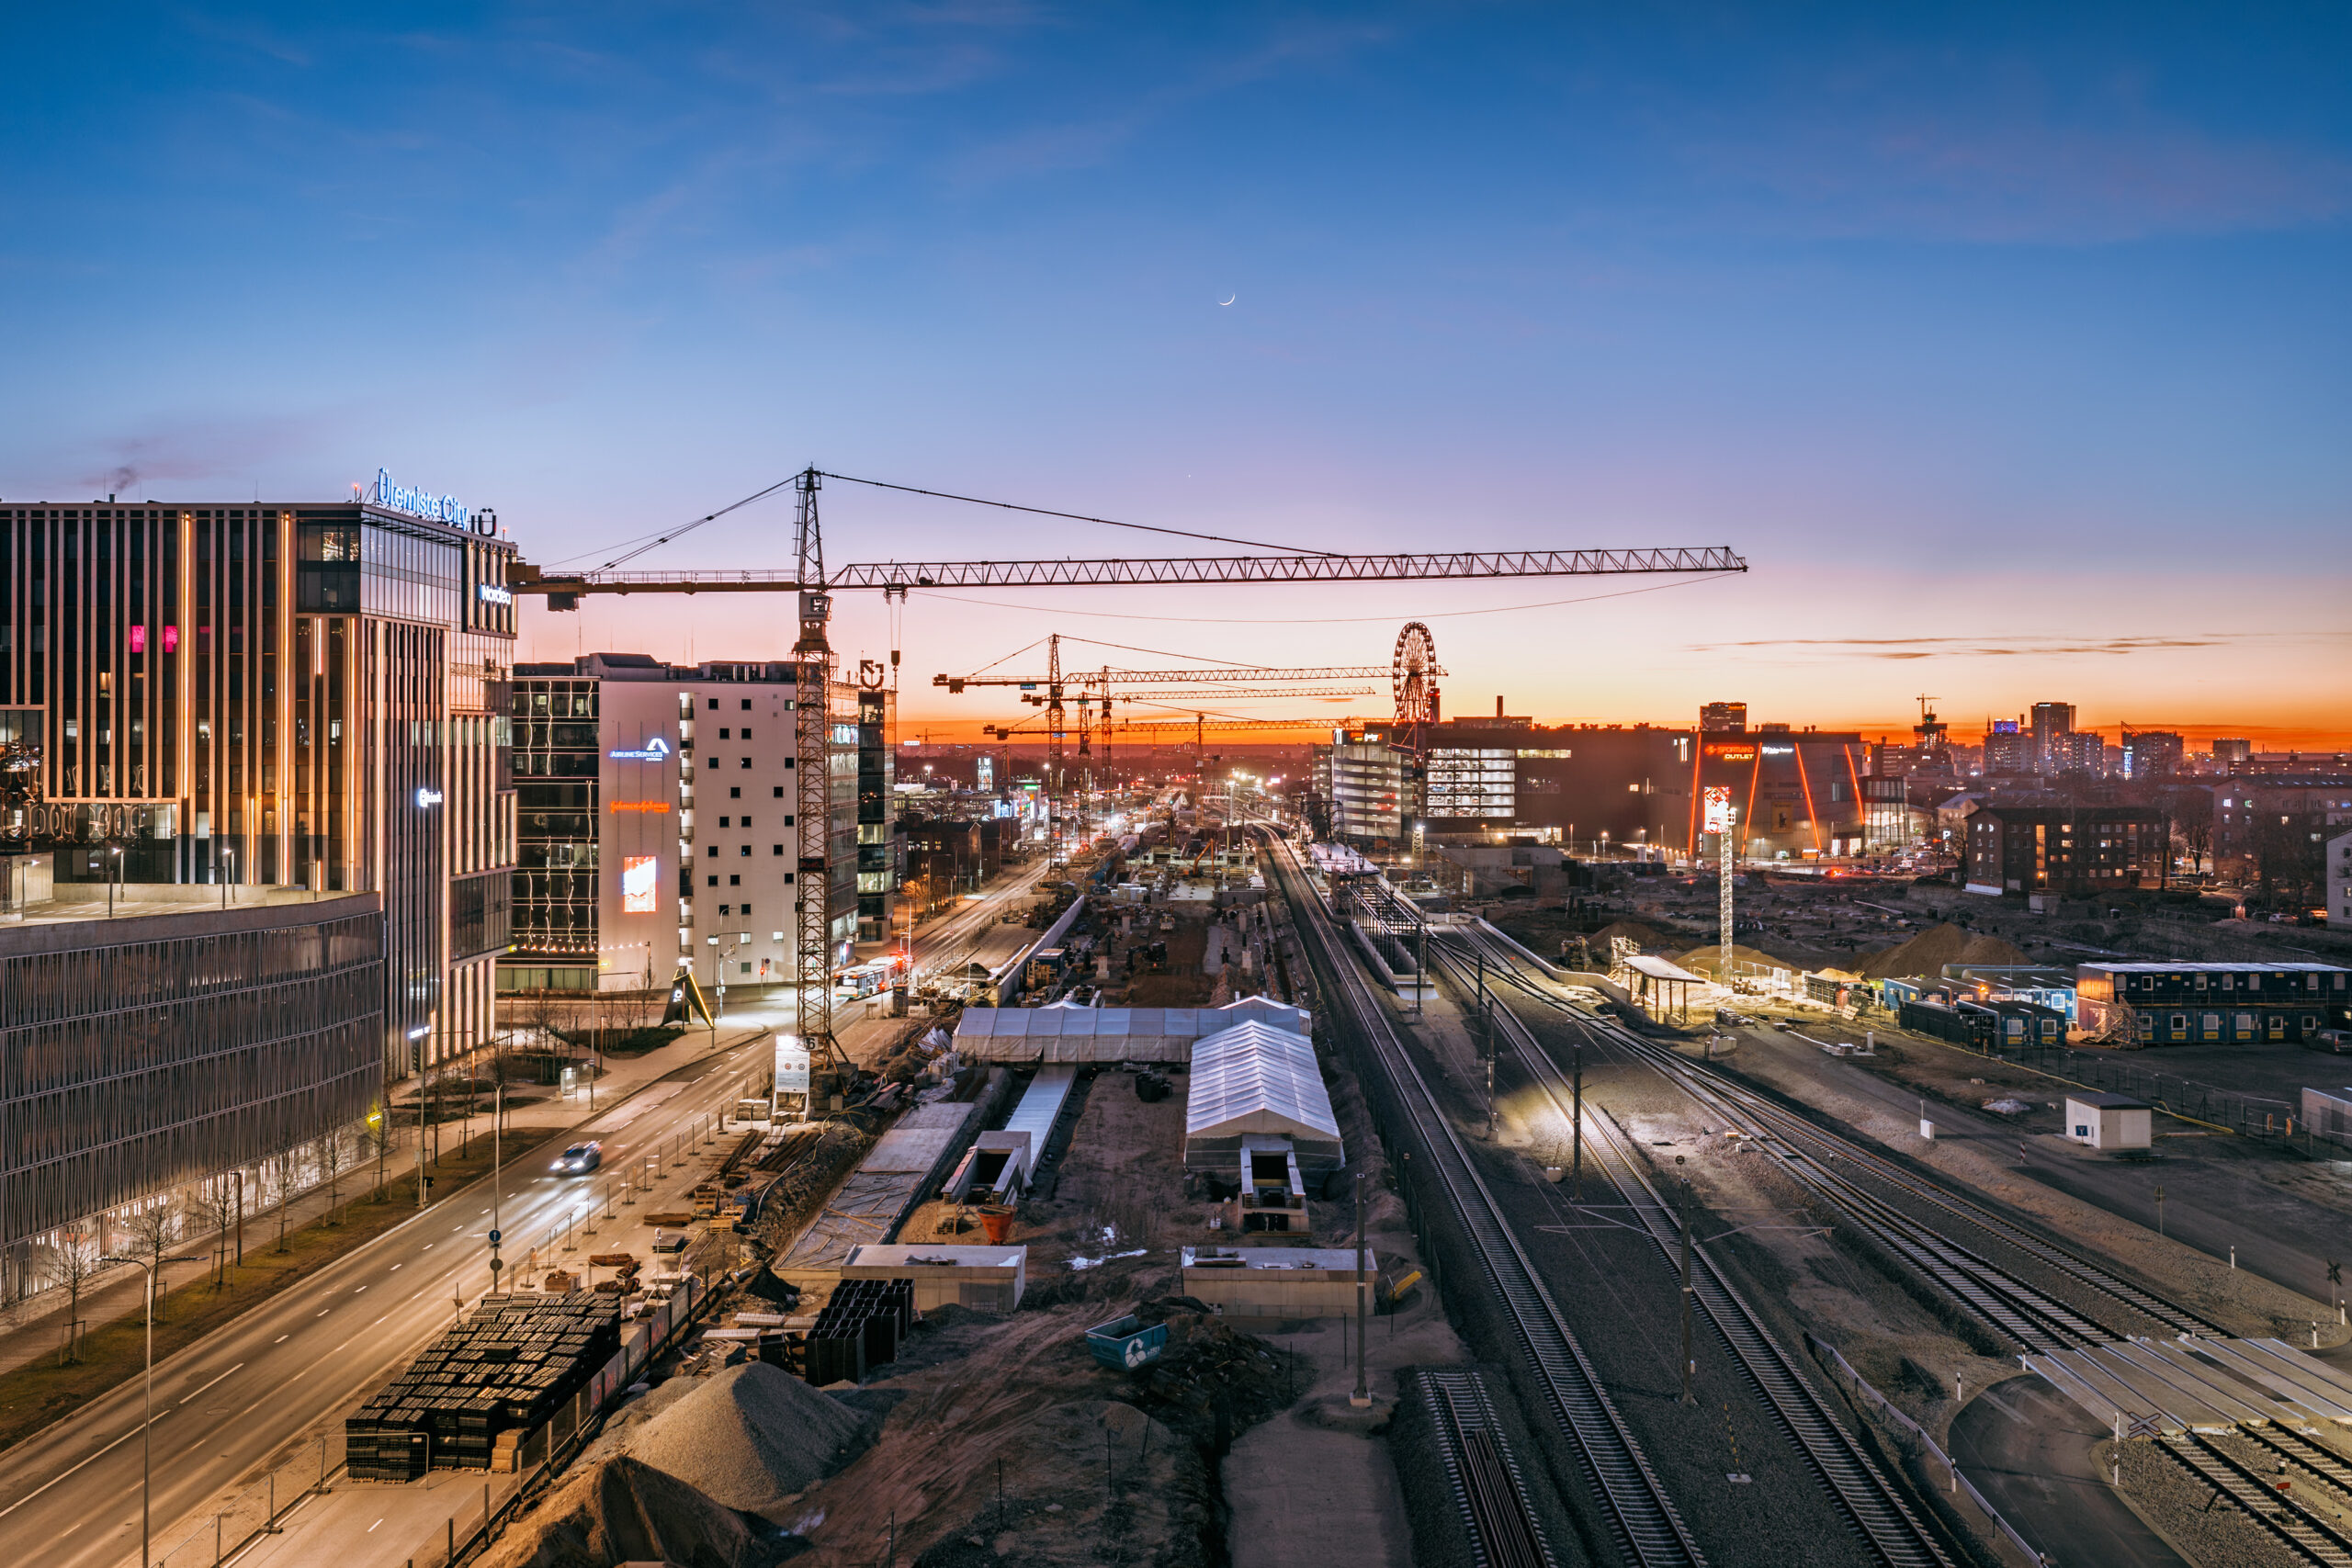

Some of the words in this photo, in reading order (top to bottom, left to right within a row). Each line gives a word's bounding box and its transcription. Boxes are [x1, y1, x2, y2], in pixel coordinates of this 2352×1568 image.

[379, 468, 440, 517] Ülemiste
[441, 494, 469, 531] City
[481, 584, 512, 605] Nordea
[1716, 746, 1754, 754] SPORTLAND
